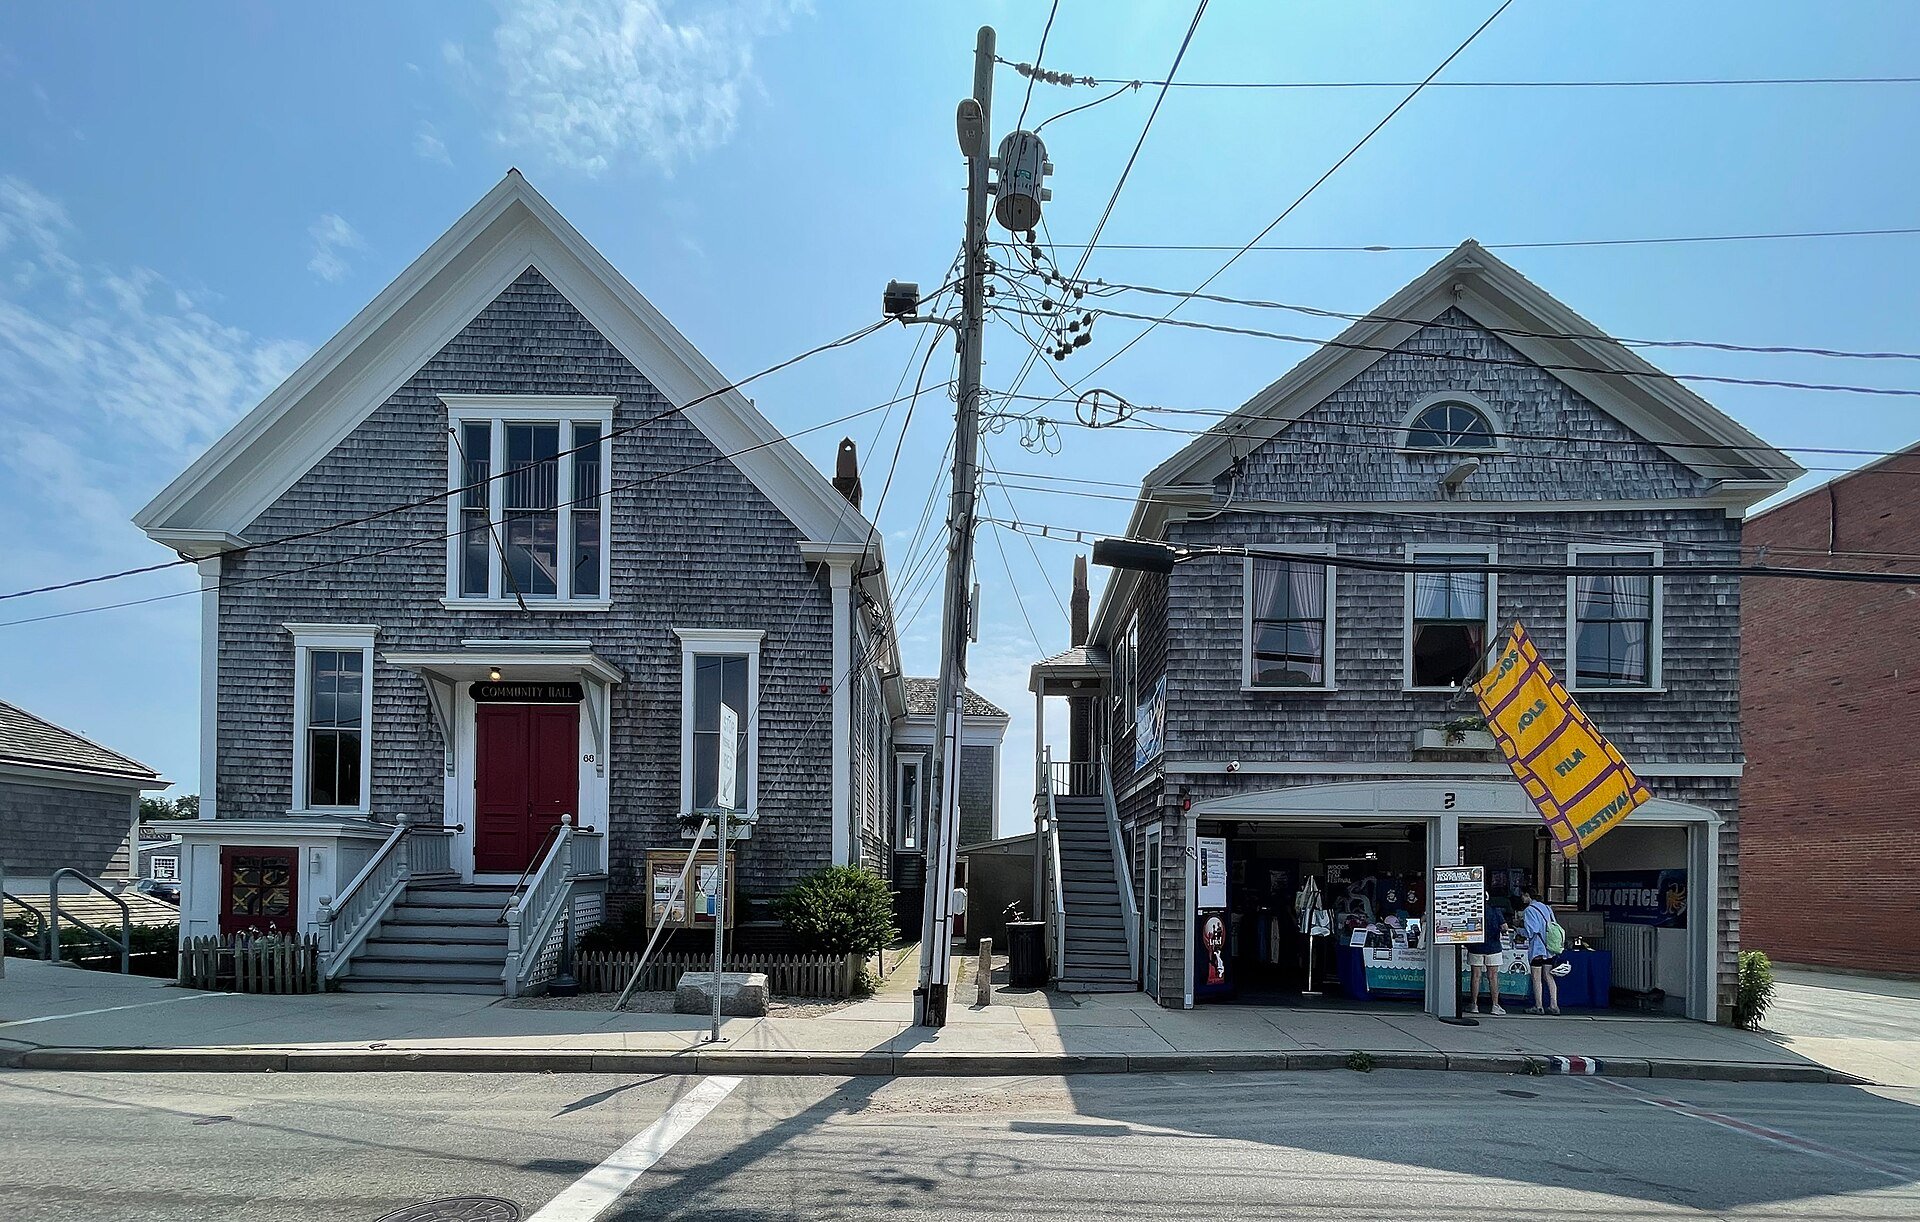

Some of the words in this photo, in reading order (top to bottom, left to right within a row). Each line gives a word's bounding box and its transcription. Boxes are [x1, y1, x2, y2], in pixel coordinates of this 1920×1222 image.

[481, 686, 543, 697] COMMUNITY
[548, 686, 573, 698] HALL
[583, 754, 595, 763] 68
[1555, 748, 1587, 777] FILM
[1576, 791, 1629, 837] FESTIVAL
[1591, 889, 1612, 906] BOX
[1614, 888, 1659, 907] OFFICE
